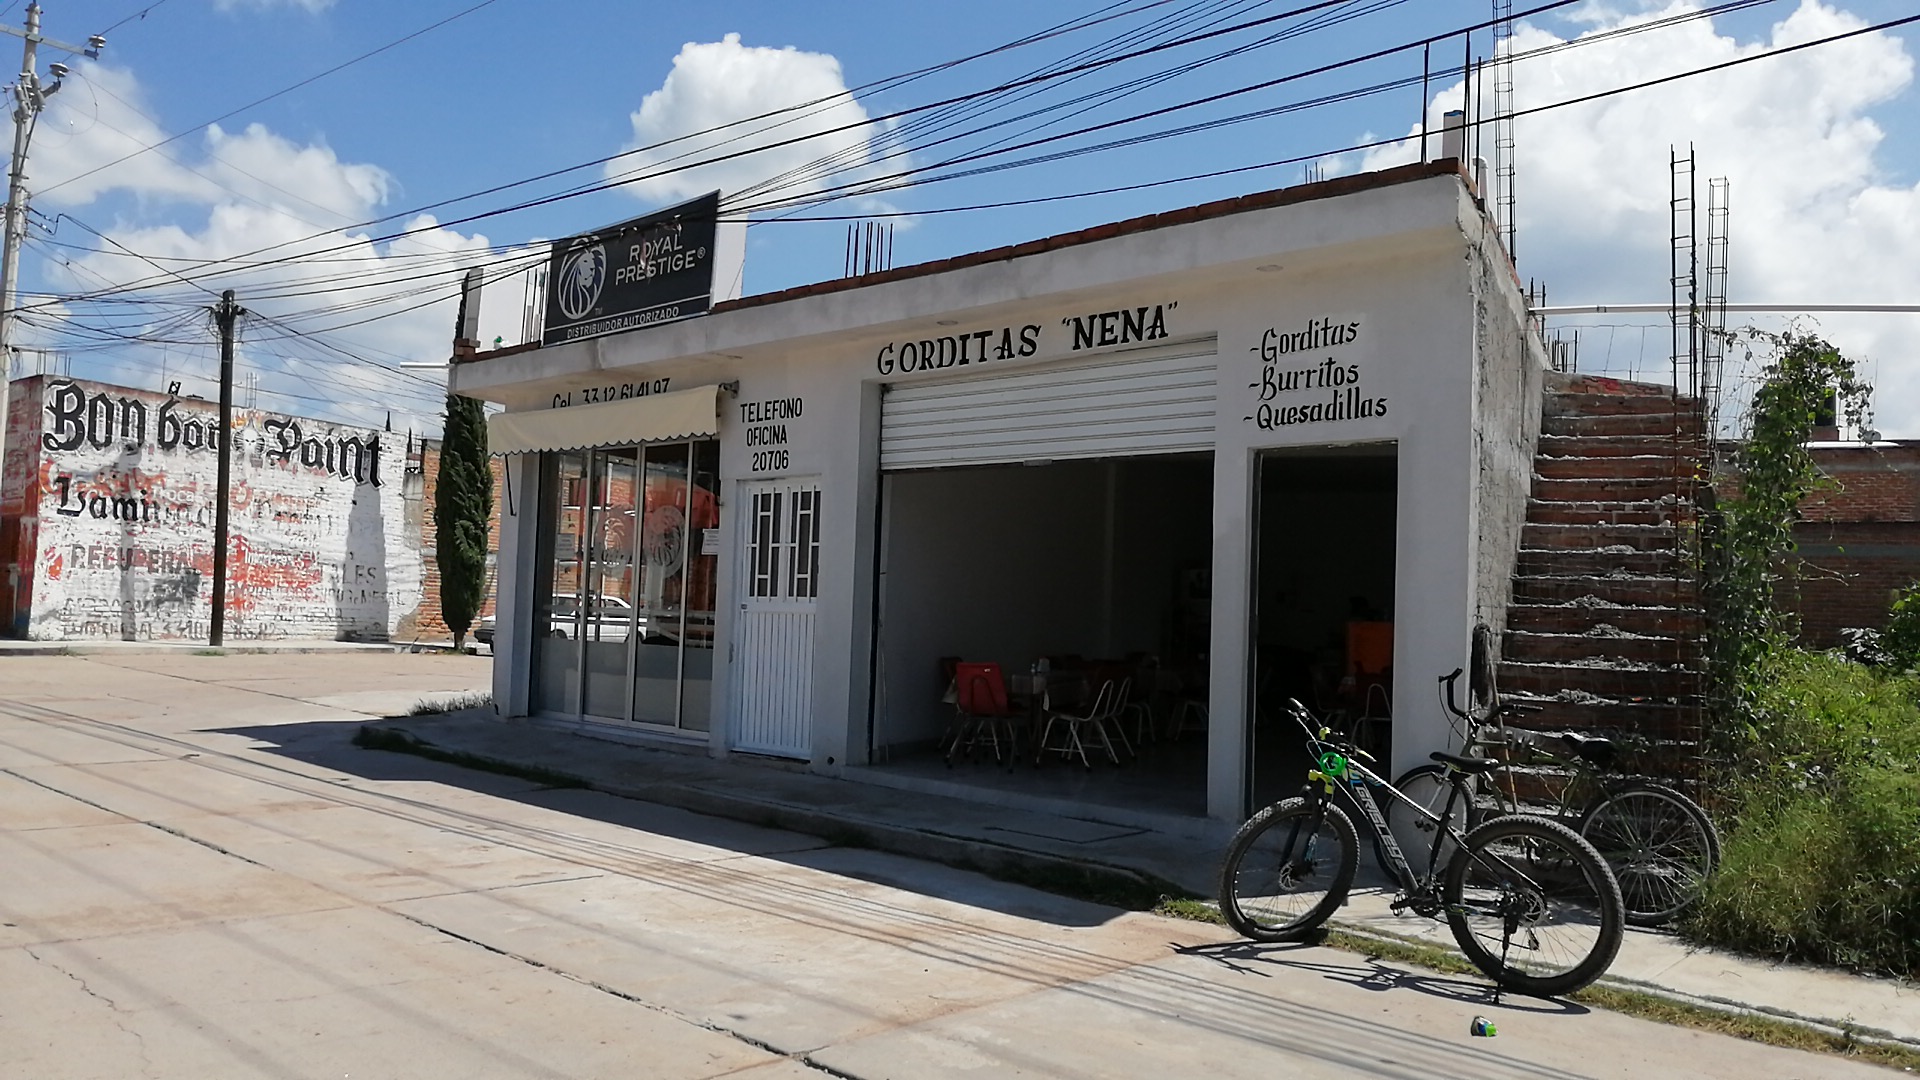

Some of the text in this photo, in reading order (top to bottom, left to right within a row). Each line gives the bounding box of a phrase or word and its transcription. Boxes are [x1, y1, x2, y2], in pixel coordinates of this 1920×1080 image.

[629, 233, 683, 262] ROYAL
[877, 324, 1042, 376] GORDITAS
[740, 397, 803, 424] TELEFONO
[42, 379, 148, 452] Bon
[263, 418, 383, 488] Paint
[746, 424, 788, 447] OFICINA
[751, 449, 790, 472] 20706
